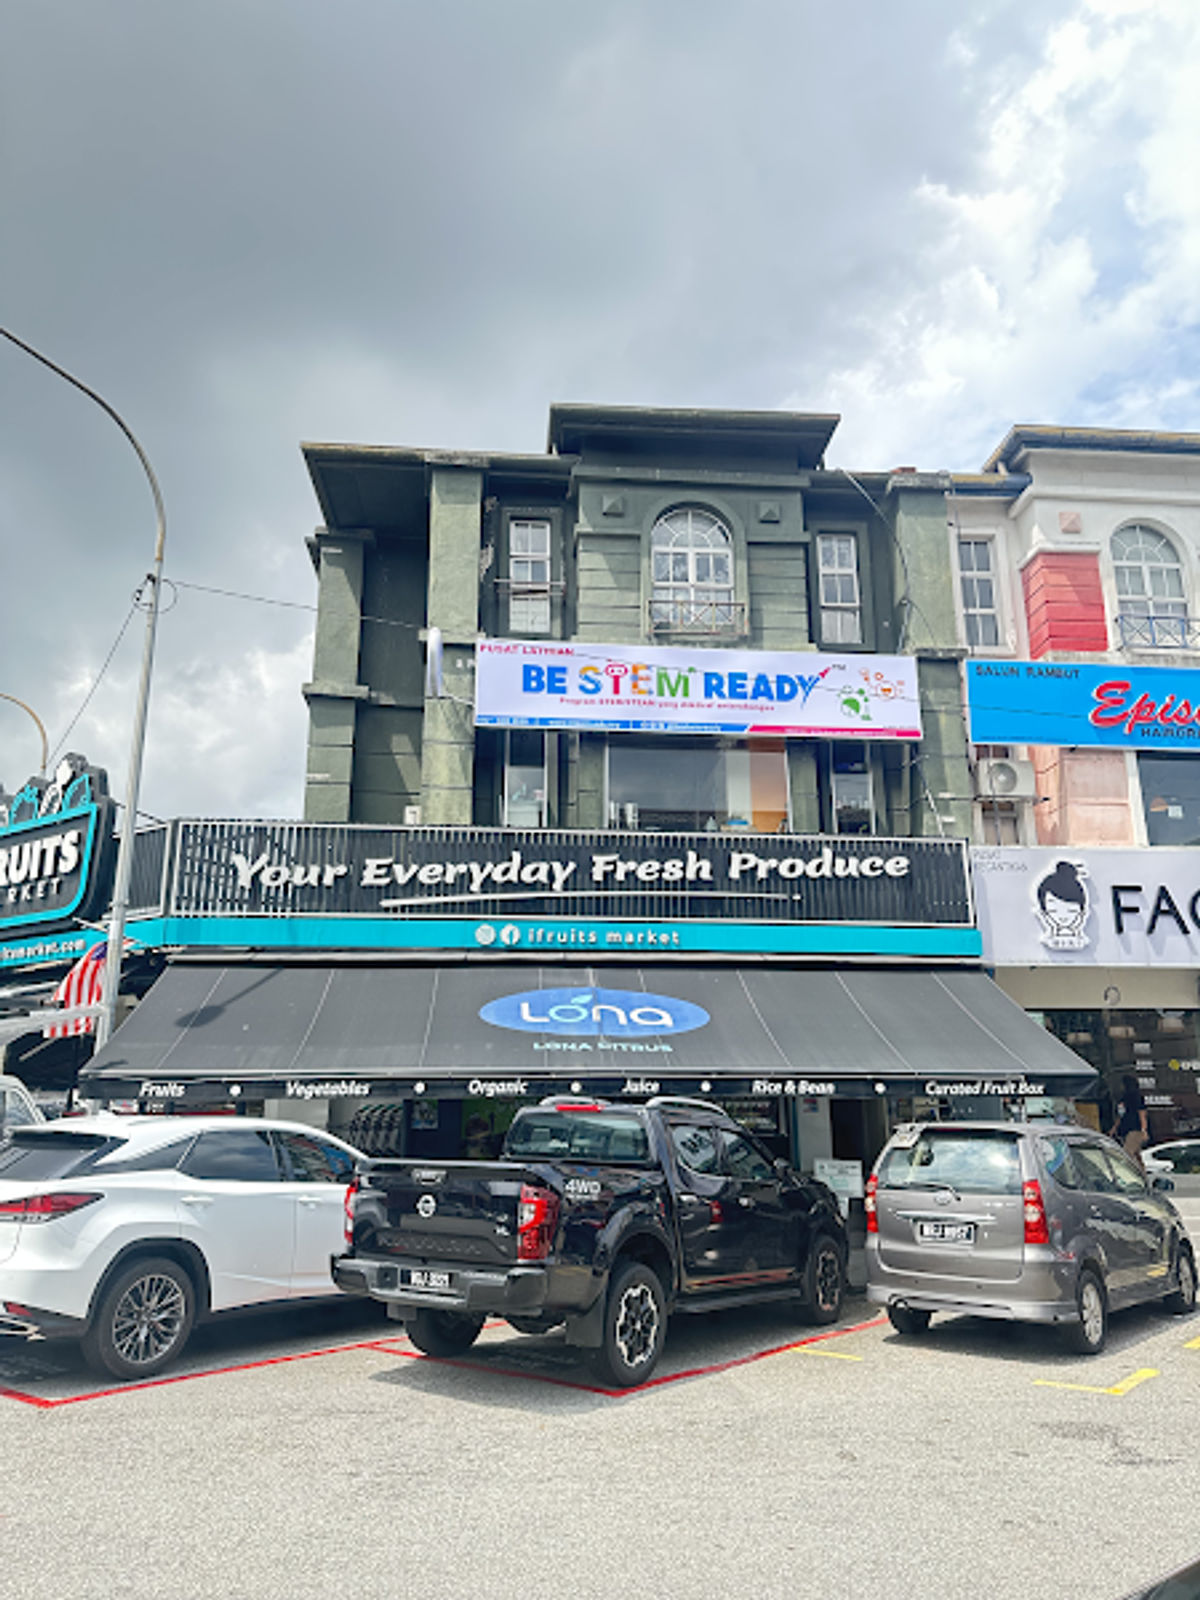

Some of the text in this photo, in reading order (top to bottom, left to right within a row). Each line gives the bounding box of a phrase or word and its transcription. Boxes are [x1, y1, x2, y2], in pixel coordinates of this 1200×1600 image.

[1026, 667, 1079, 679] RAMBUT
[522, 662, 821, 709] BE STEM READY
[1088, 680, 1200, 735] Epis
[232, 848, 910, 892] Your Everyday Fresh Produce
[528, 929, 680, 946] ifruits market
[520, 995, 674, 1028] Lona
[532, 1041, 673, 1053] LONA CITRUS
[138, 1081, 185, 1098] Fruits
[285, 1079, 370, 1099] Vegetables
[468, 1078, 528, 1098] Organic
[621, 1078, 661, 1094] Juice
[751, 1080, 836, 1095] Rice & Bean
[925, 1080, 1046, 1096] Curated Fruit Box
[565, 1178, 601, 1193] 4WD
